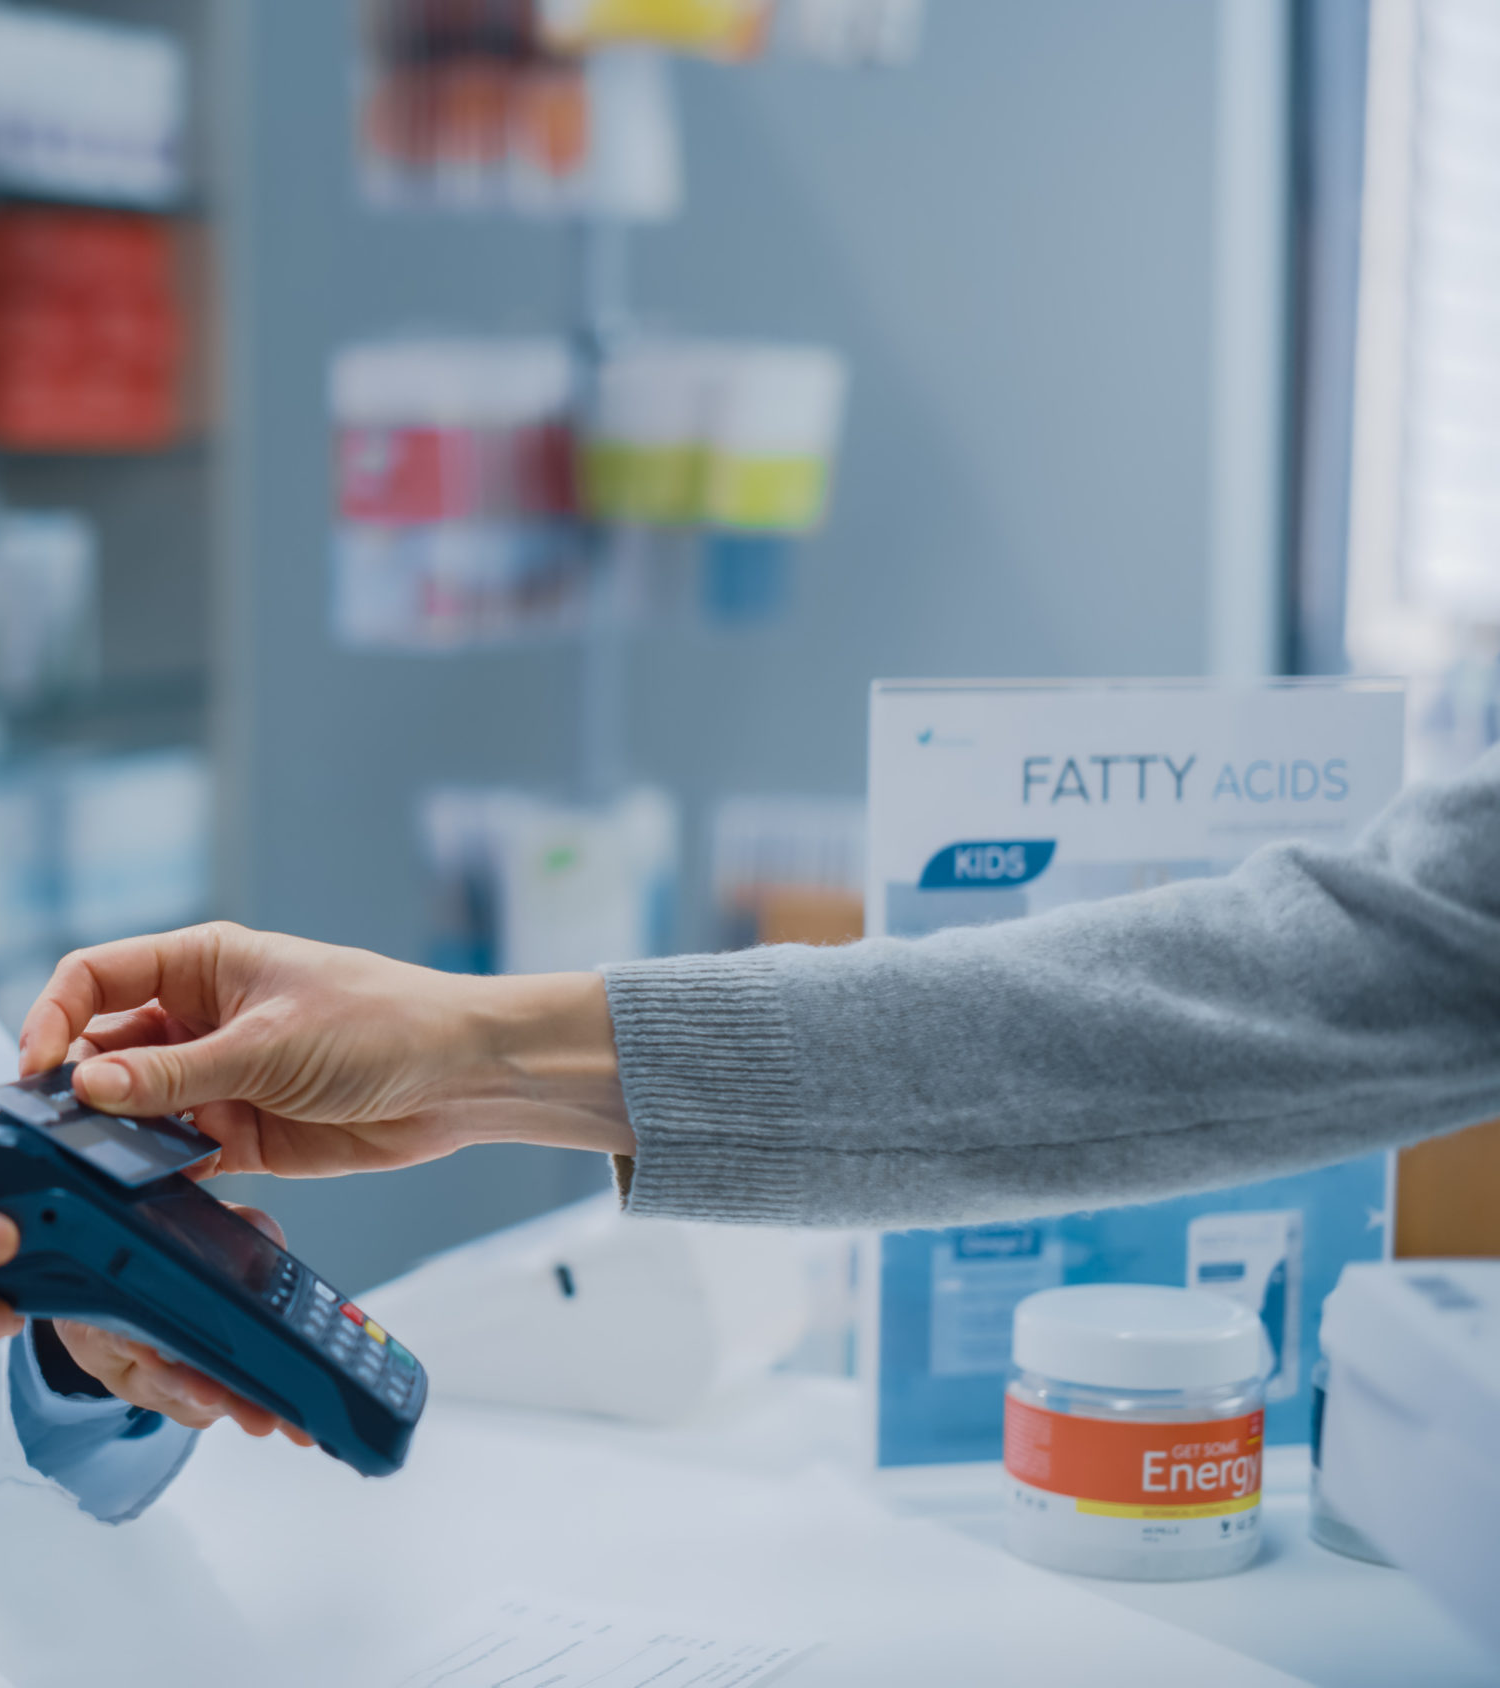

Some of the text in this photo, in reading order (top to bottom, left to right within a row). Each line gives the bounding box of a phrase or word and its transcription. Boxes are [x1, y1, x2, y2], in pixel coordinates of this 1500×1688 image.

[1021, 754, 1350, 804] FATTY ACIDS
[953, 844, 1026, 880] KIDS
[1171, 1438, 1239, 1460] GET SOME
[1142, 1450, 1258, 1498] Energy
